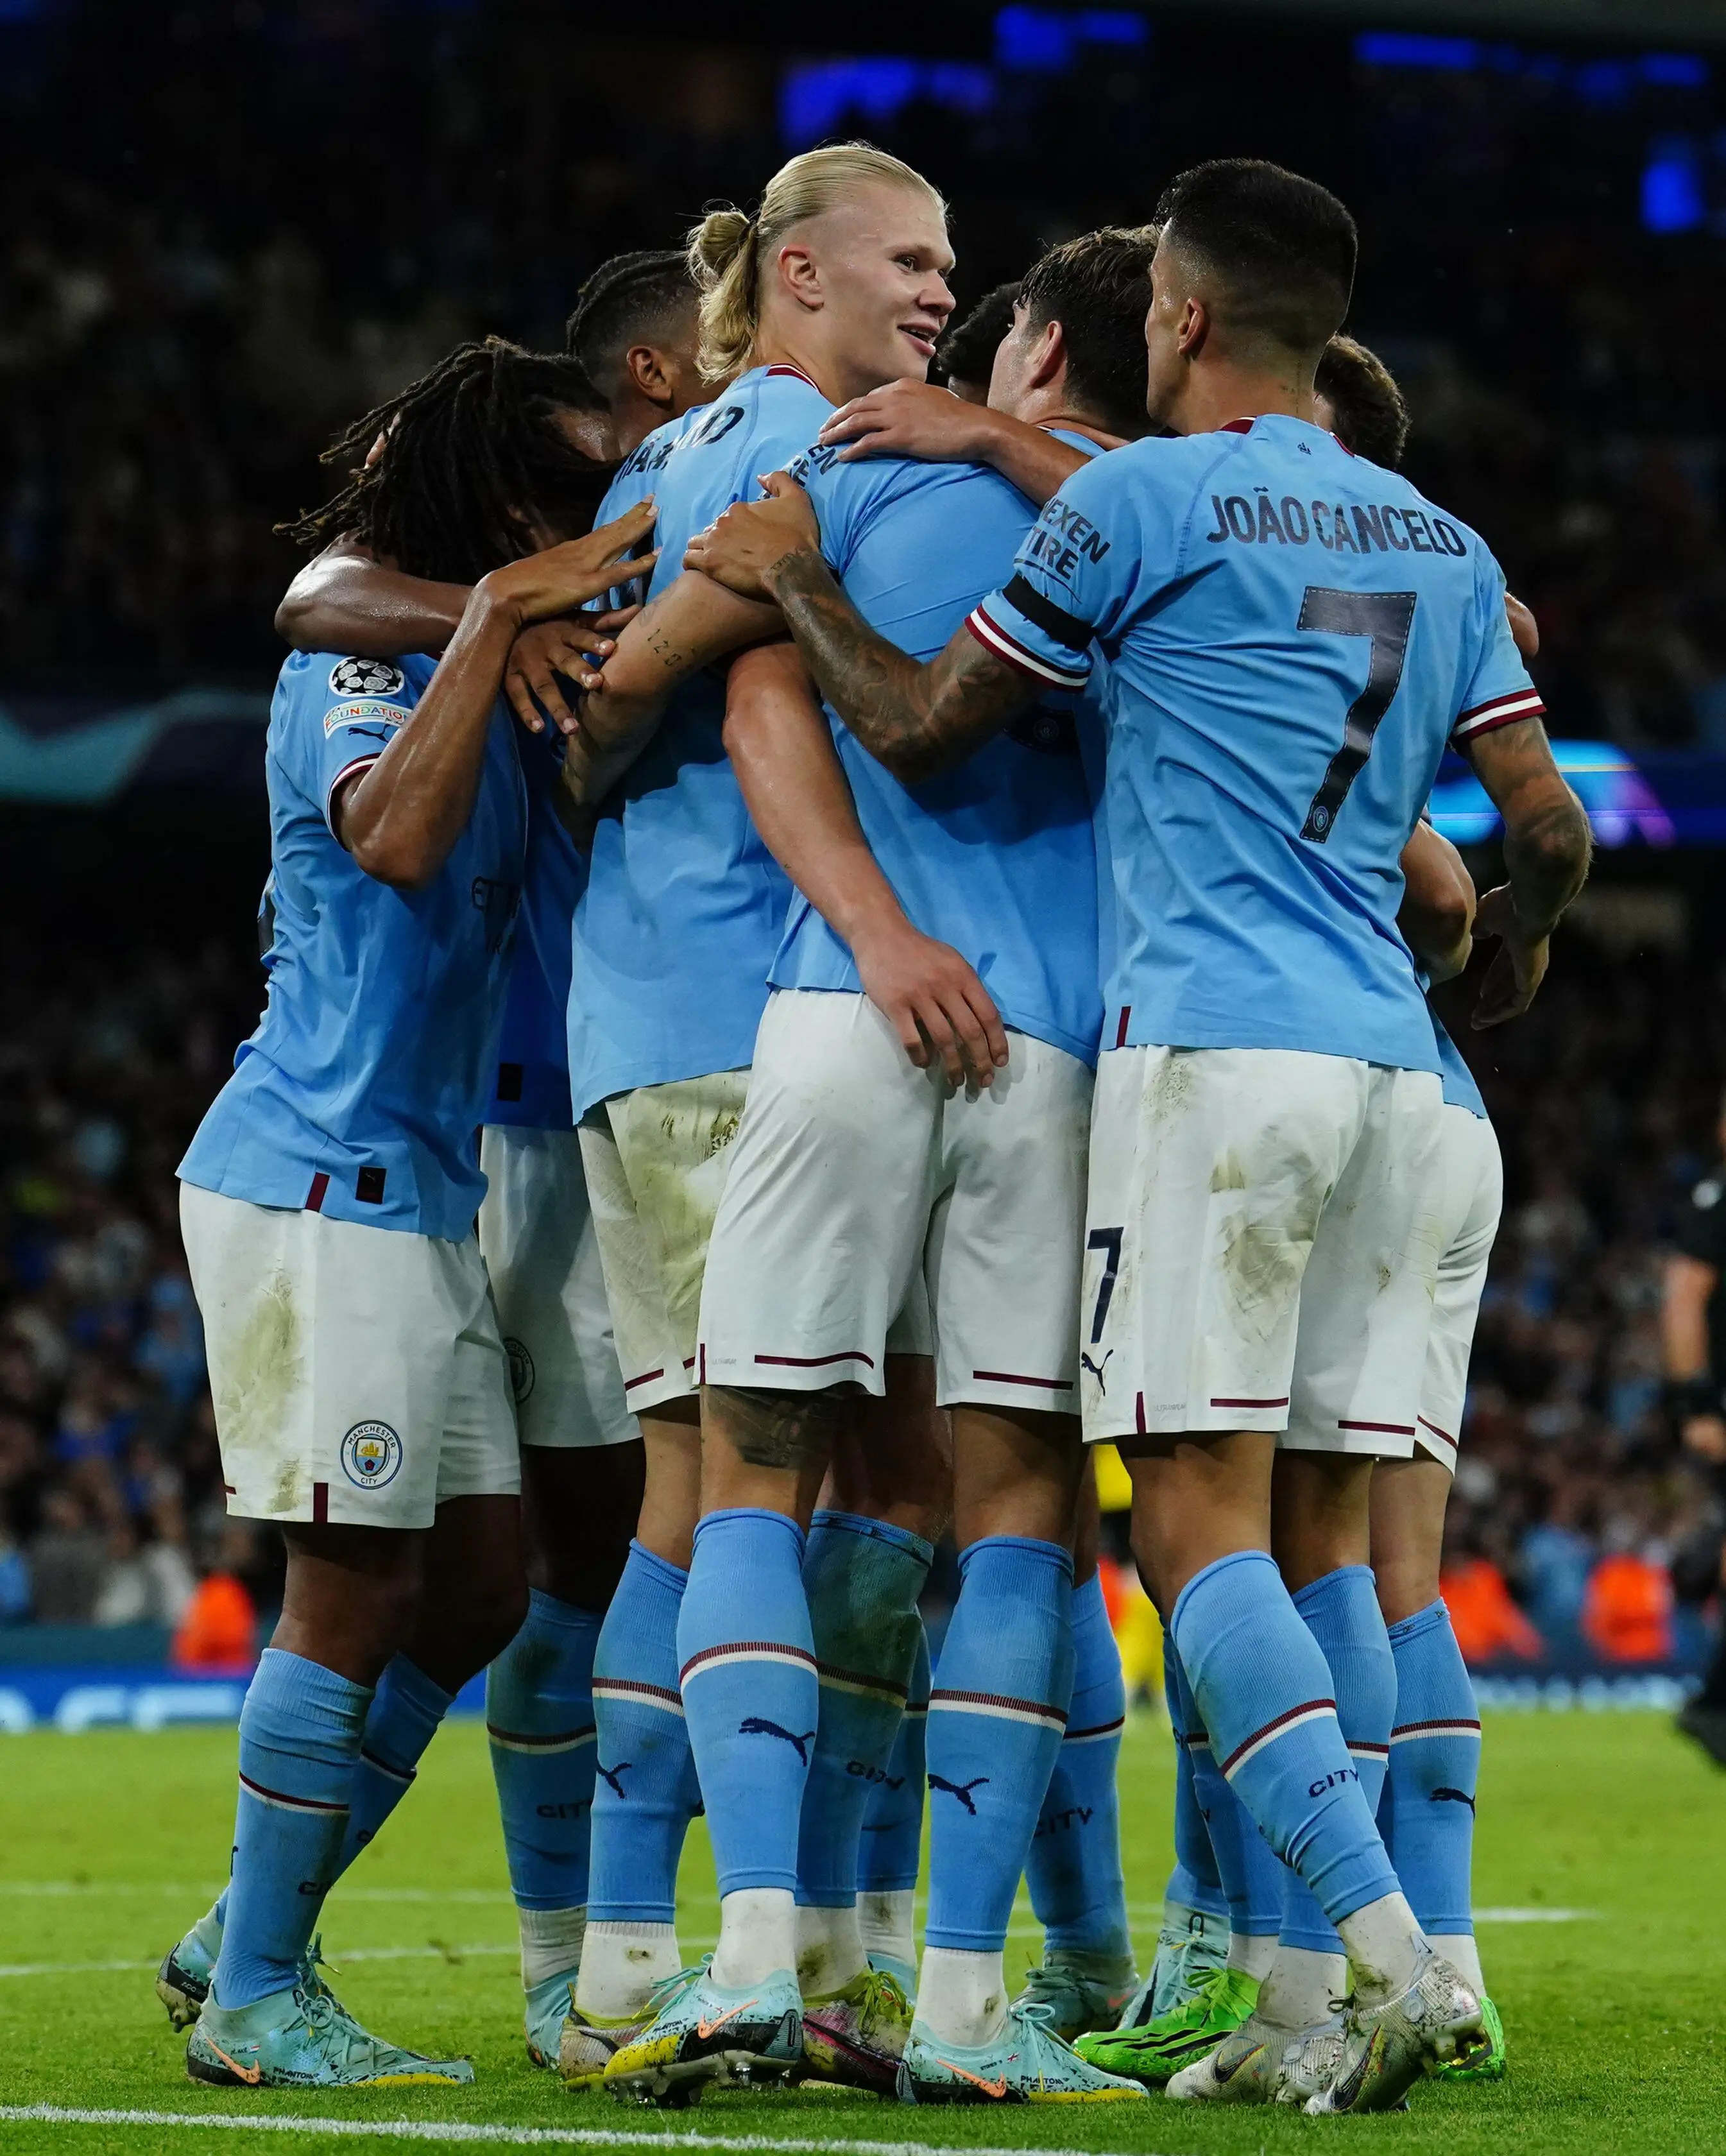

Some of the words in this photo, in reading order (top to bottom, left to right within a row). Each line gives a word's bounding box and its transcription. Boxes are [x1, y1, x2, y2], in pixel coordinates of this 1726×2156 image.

[1206, 486, 1310, 545] JOÃO
[1311, 499, 1467, 558] CANCELO
[1026, 526, 1079, 580] TIRE
[1297, 585, 1417, 844] 7
[1087, 1226, 1124, 1344] 7
[348, 1425, 396, 1449] MANCHESTER
[1308, 1768, 1358, 1797] CITY
[1021, 2075, 1064, 2085] PHATOM
